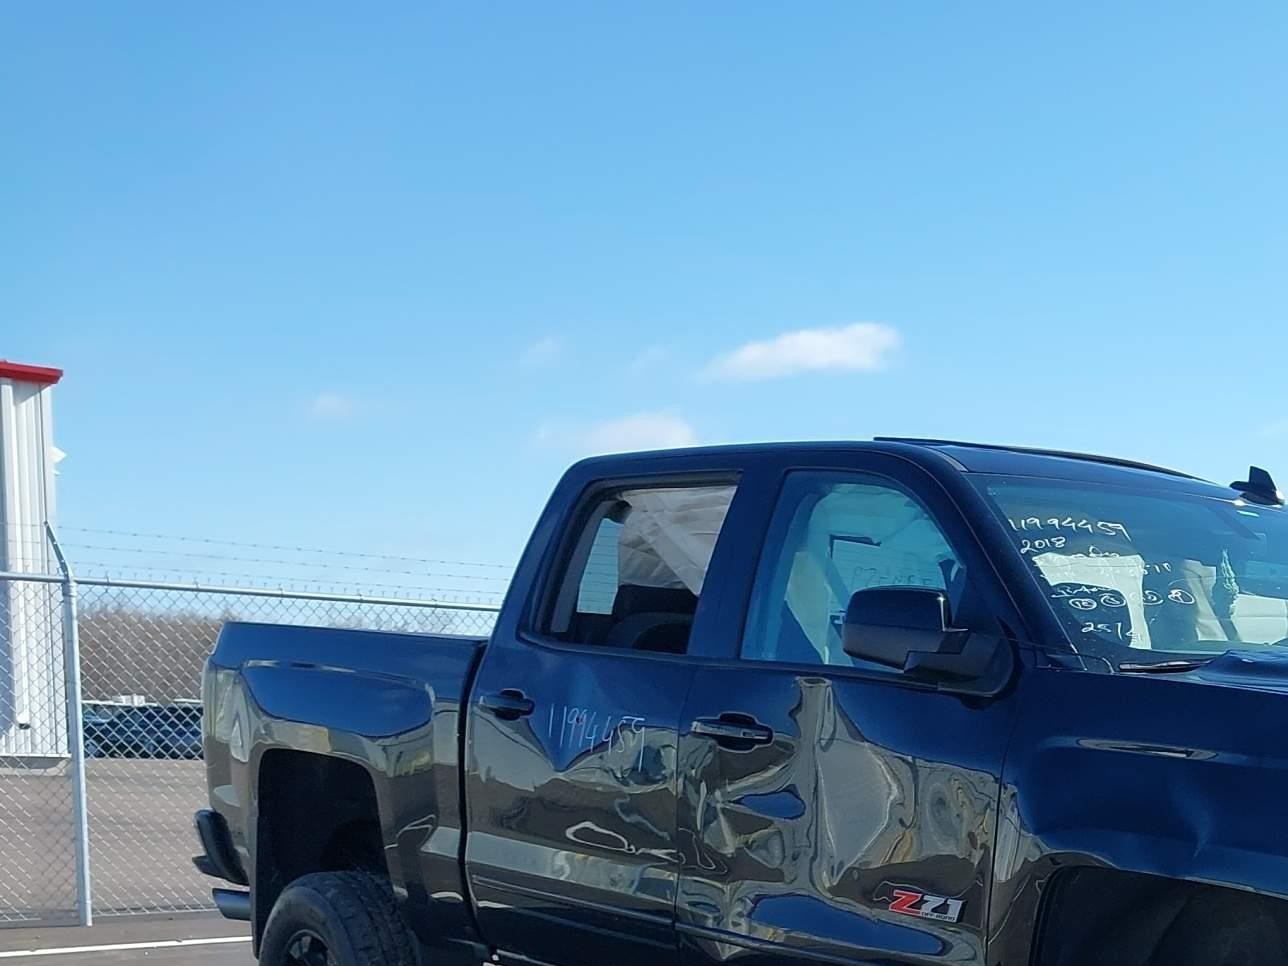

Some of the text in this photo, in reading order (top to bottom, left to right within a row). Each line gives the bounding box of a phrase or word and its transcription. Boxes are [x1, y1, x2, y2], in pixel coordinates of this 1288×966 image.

[1007, 516, 1132, 542] 11994459
[1020, 536, 1066, 554] 2018
[548, 703, 645, 773] 11994459
[888, 889, 964, 923] Z71
